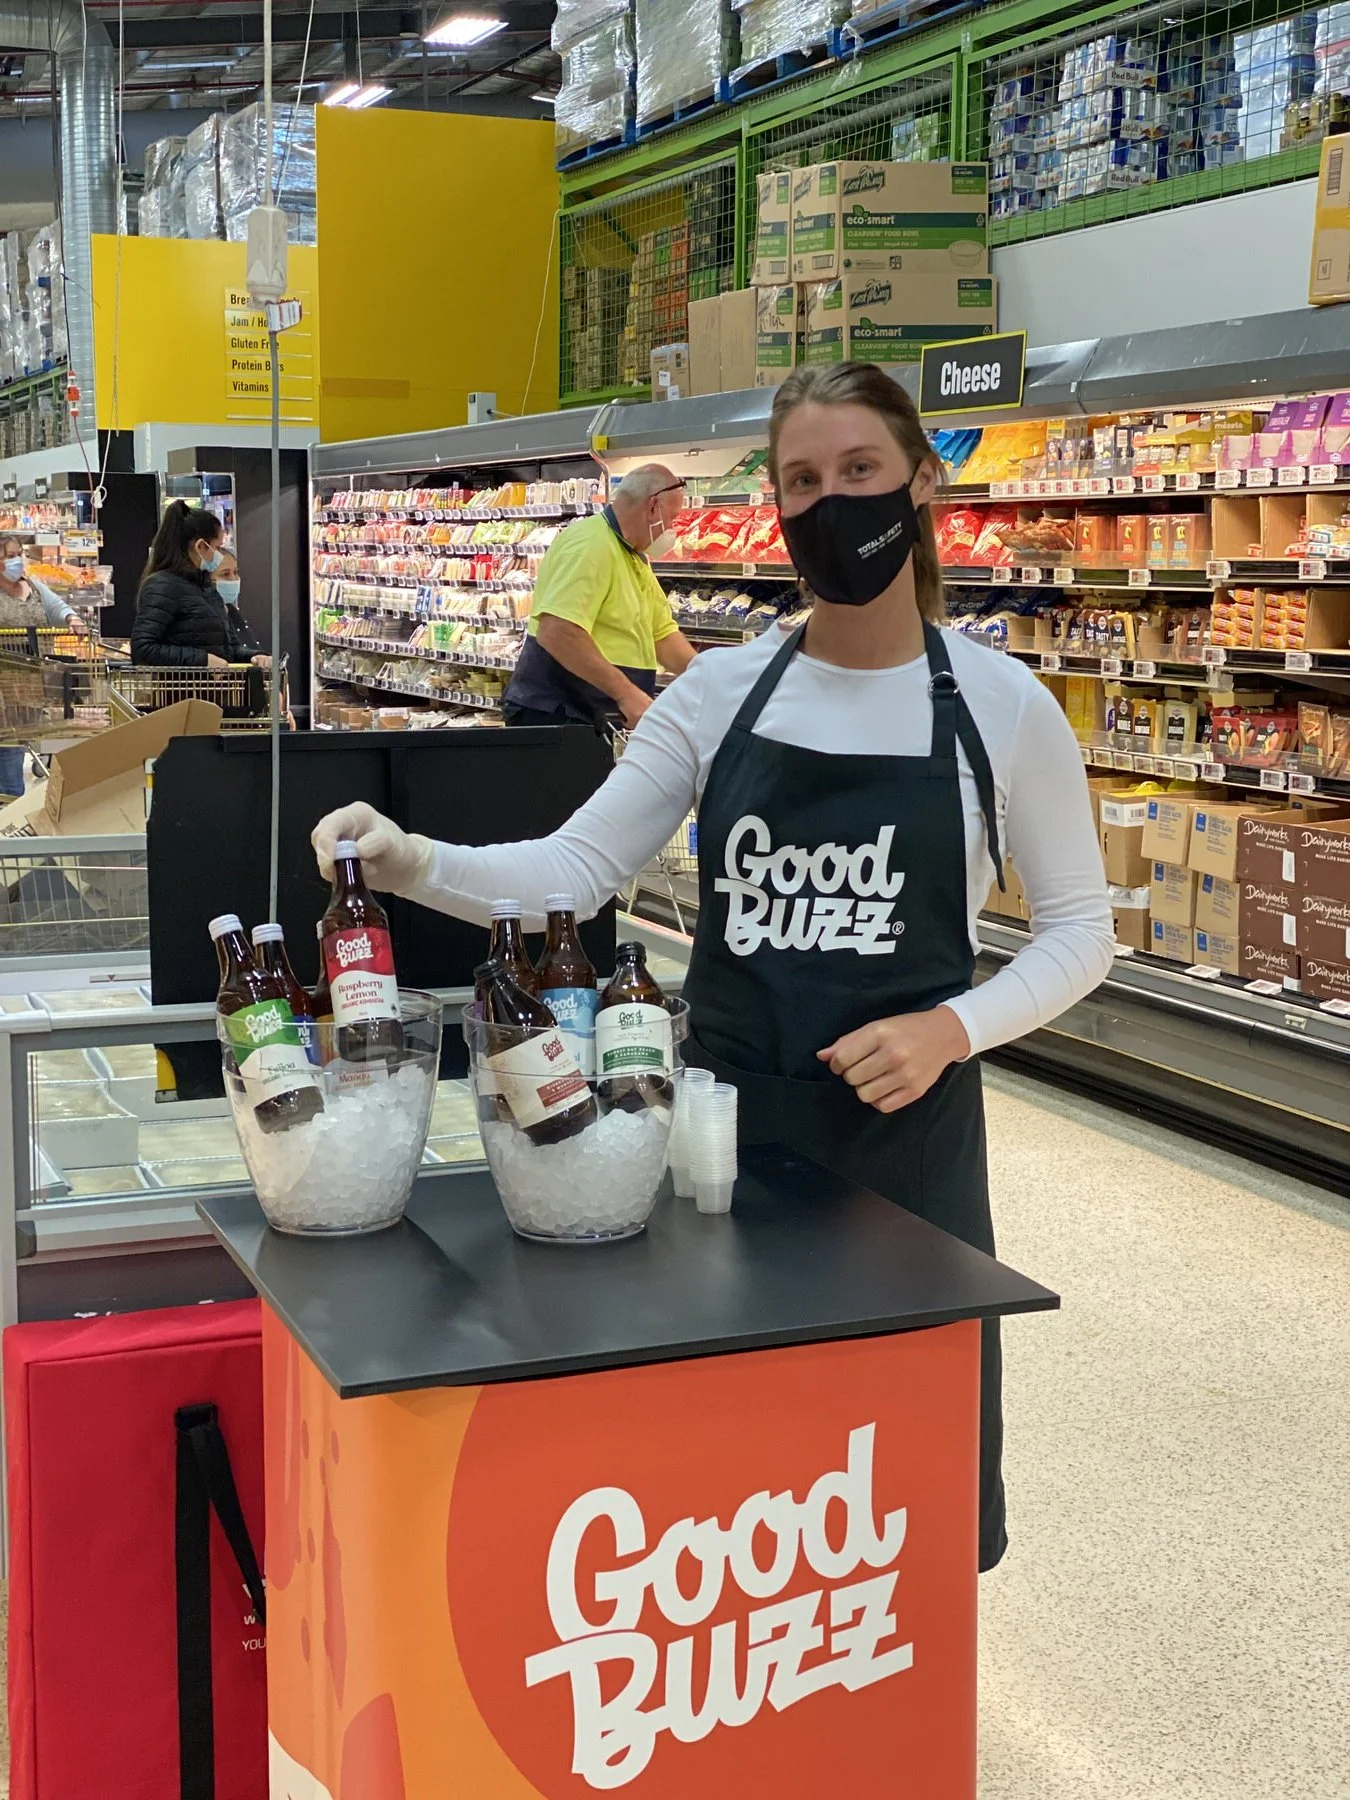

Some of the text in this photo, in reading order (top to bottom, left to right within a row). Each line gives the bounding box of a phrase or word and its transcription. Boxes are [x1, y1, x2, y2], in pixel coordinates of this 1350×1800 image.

[231, 316, 249, 327] Jam
[231, 338, 279, 350] Gluten Fre
[232, 359, 262, 371] Protein
[232, 381, 269, 392] Vitamins
[941, 360, 1001, 396] Cheese
[1243, 820, 1289, 842] Dairyworks
[725, 815, 905, 899] Good
[1245, 884, 1289, 906] Dairyworks
[336, 932, 371, 955] Good
[1245, 945, 1289, 968] Dairyworks
[1307, 961, 1350, 984] Dairywork
[338, 980, 383, 994] Raspberry
[345, 990, 377, 1002] Lemon
[546, 1422, 907, 1643] Good
[242, 1638, 266, 1651] YOU
